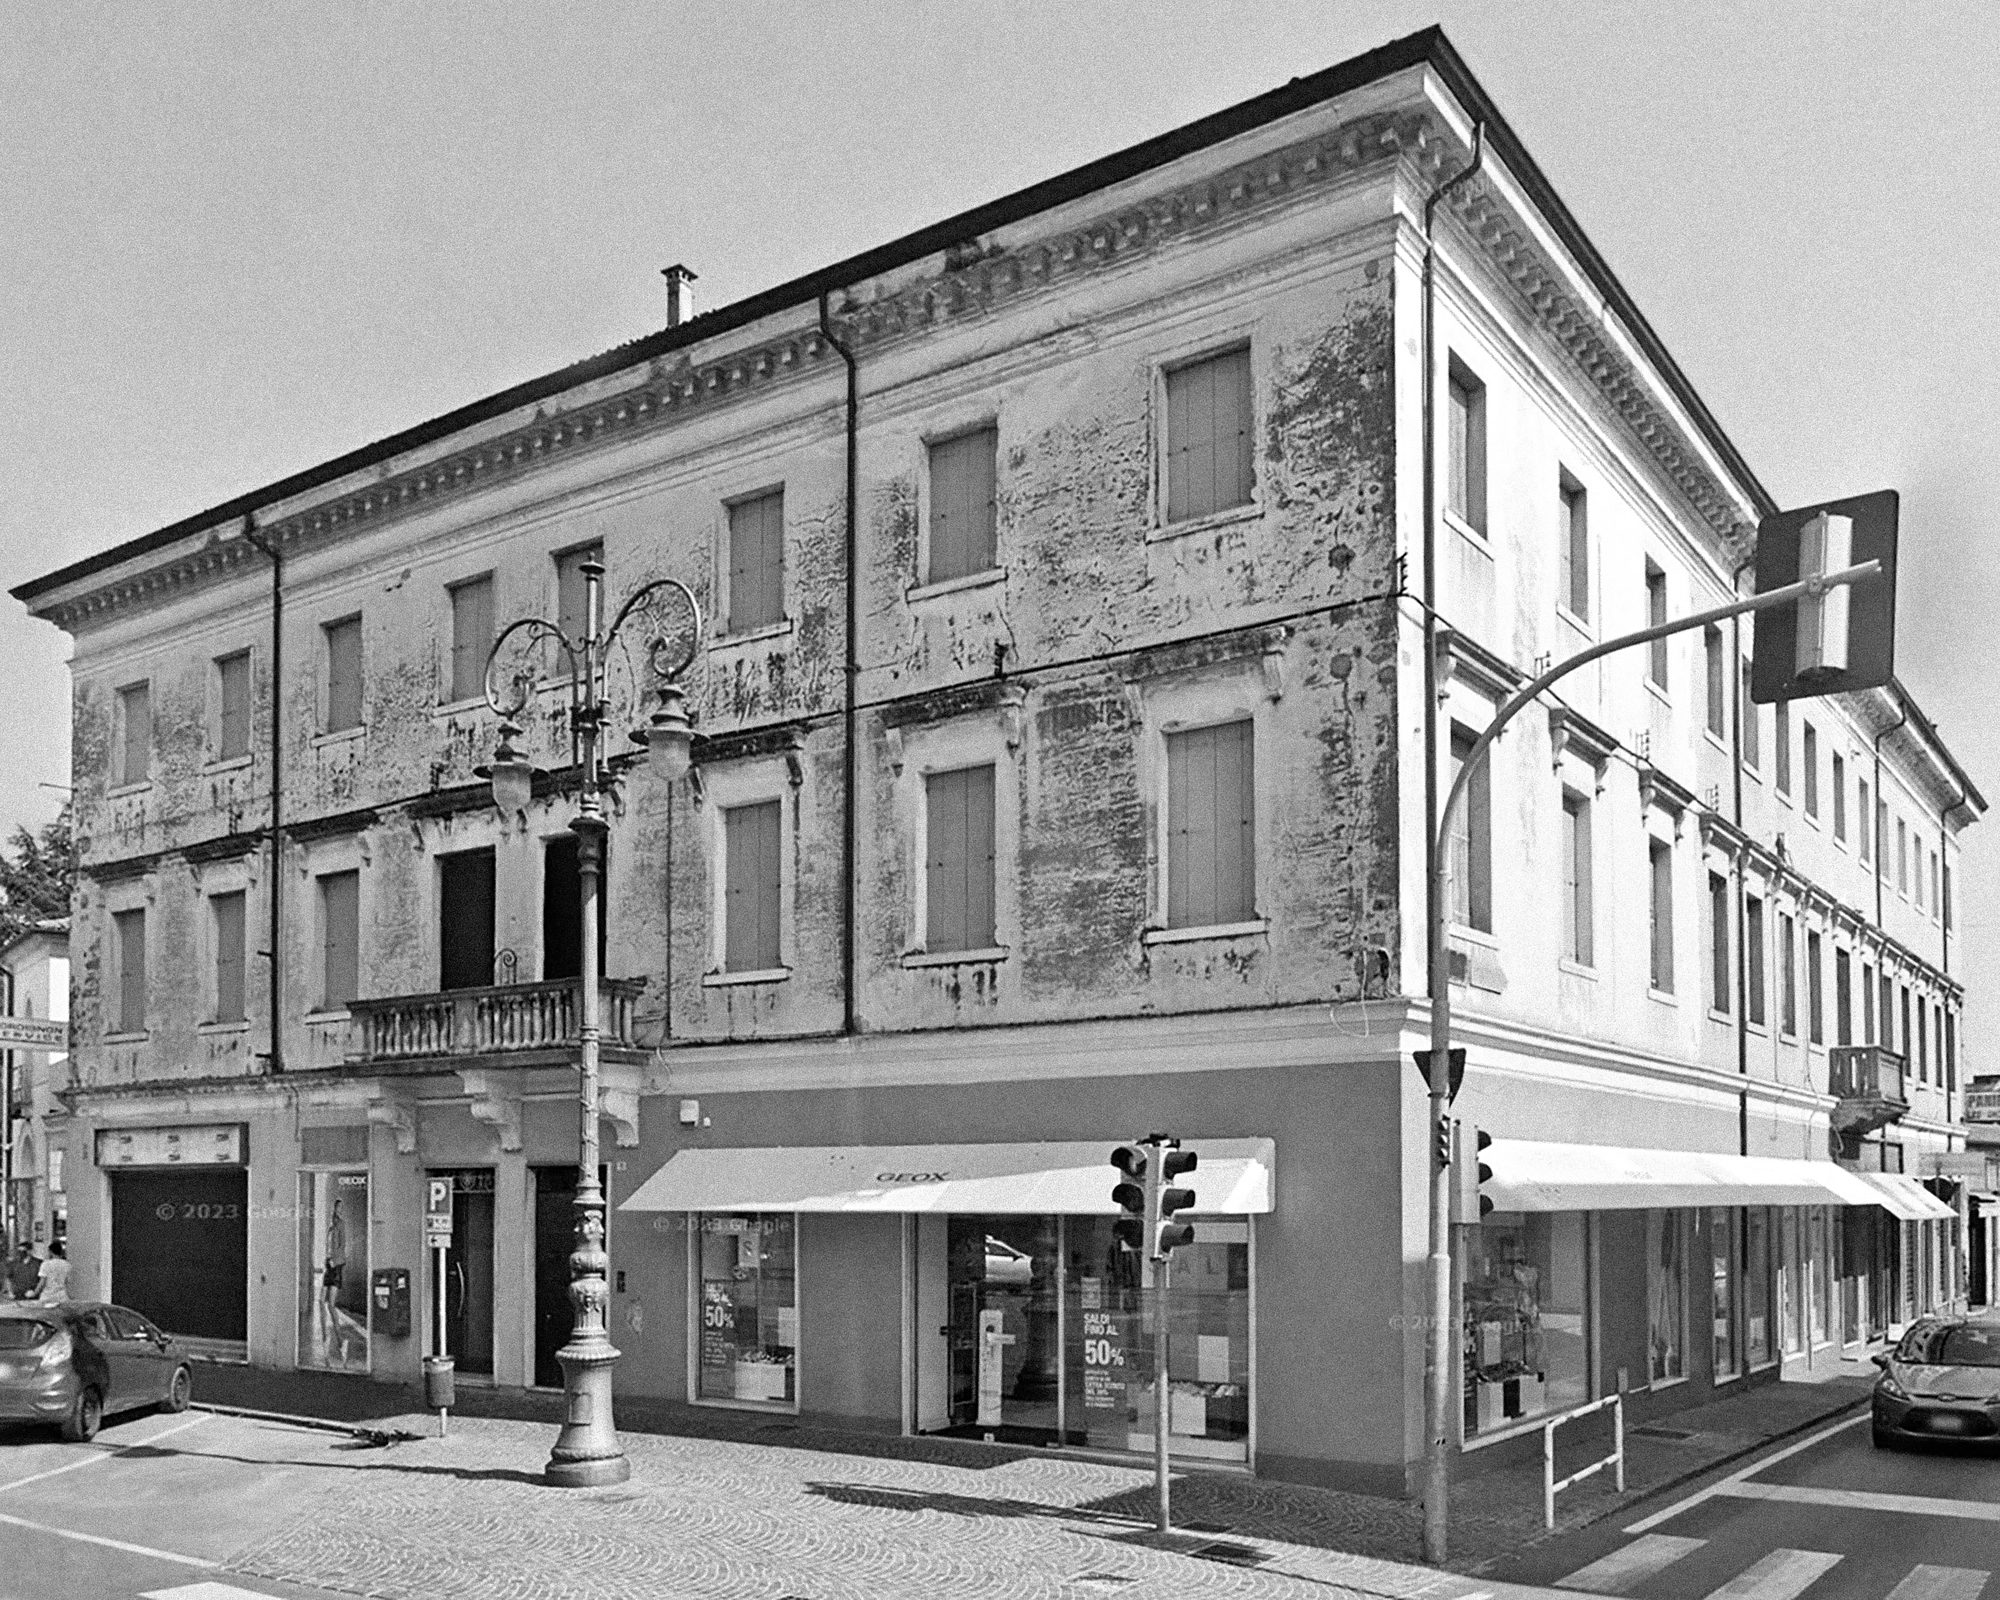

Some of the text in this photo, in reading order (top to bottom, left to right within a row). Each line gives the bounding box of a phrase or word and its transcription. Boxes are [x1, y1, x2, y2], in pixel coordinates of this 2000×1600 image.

[877, 1172, 950, 1182] GEOX
[430, 1181, 447, 1211] P
[705, 1305, 734, 1328] 50%
[1085, 1340, 1124, 1366] 50%
